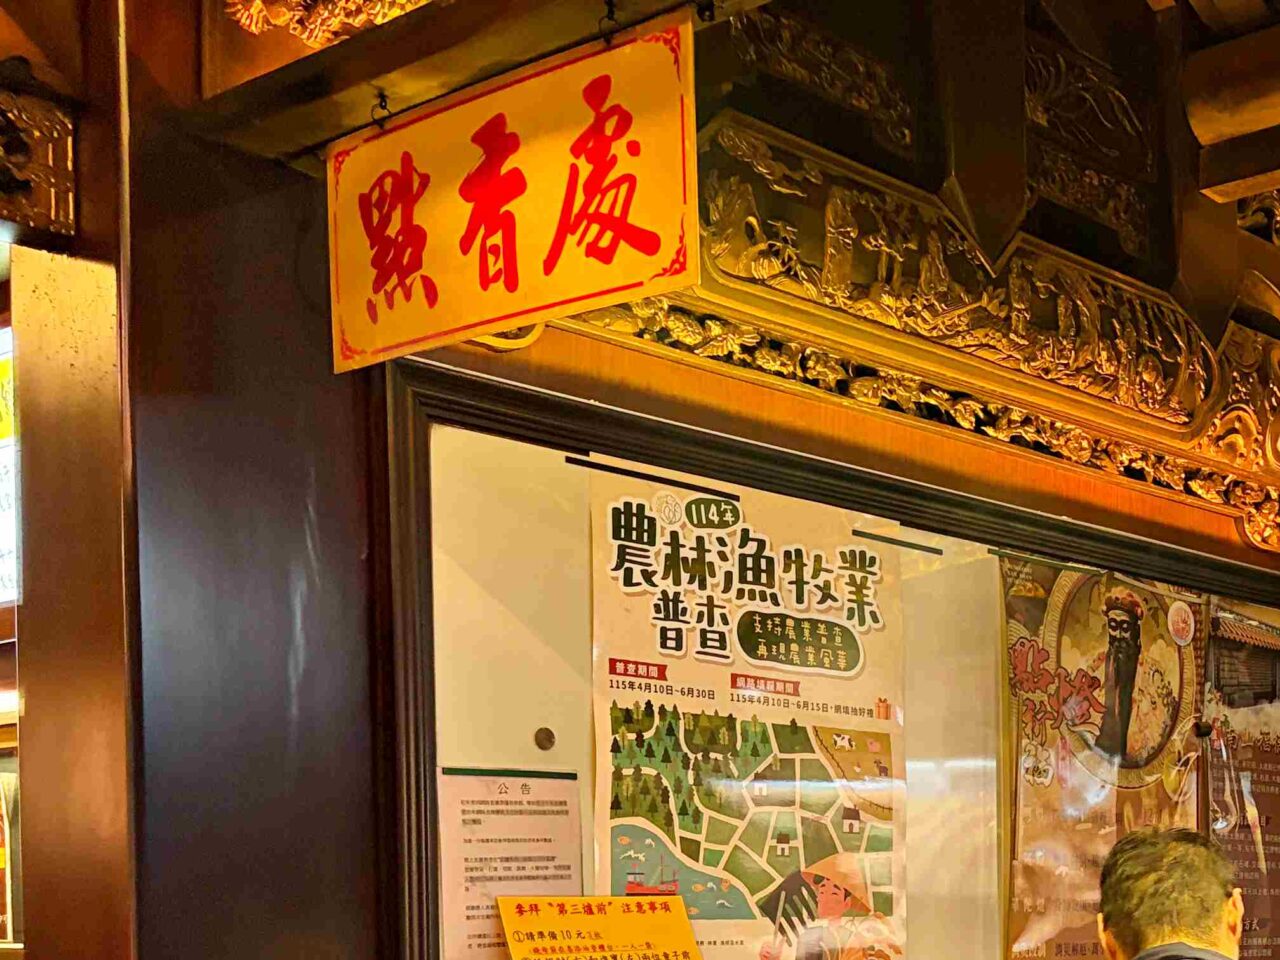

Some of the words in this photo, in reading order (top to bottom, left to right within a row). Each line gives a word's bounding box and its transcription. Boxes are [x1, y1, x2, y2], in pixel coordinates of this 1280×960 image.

[358, 74, 661, 326] 點香處
[691, 502, 736, 526] 114年
[611, 501, 880, 627] 農林漁牧業
[652, 589, 731, 660] 普查
[753, 613, 843, 647] 支持農業普查
[615, 661, 660, 680] 普查期間
[756, 638, 848, 670] 再現農業風華
